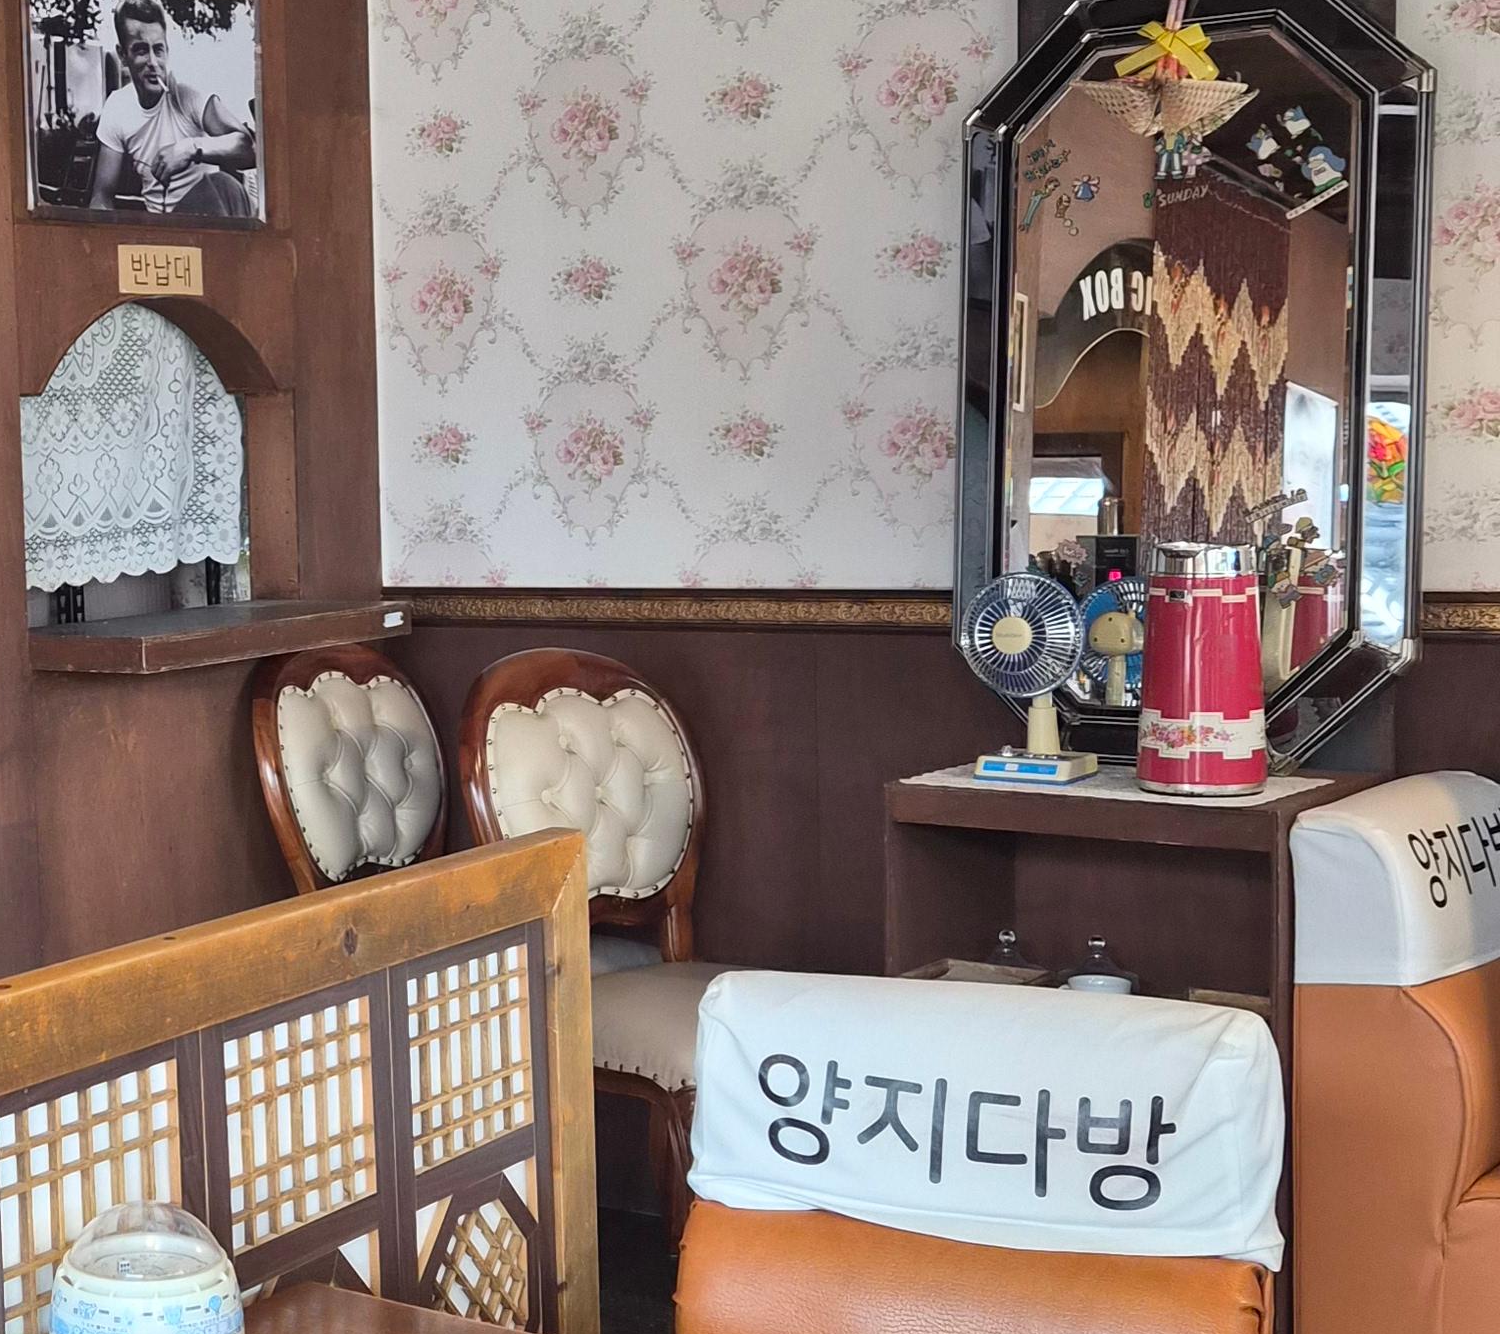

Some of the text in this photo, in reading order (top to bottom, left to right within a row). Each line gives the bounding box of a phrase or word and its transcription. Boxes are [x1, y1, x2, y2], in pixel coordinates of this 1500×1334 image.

[1158, 185, 1209, 207] SUNDAY
[130, 253, 192, 288] 반납대
[757, 1053, 1177, 1211] 양지다방
